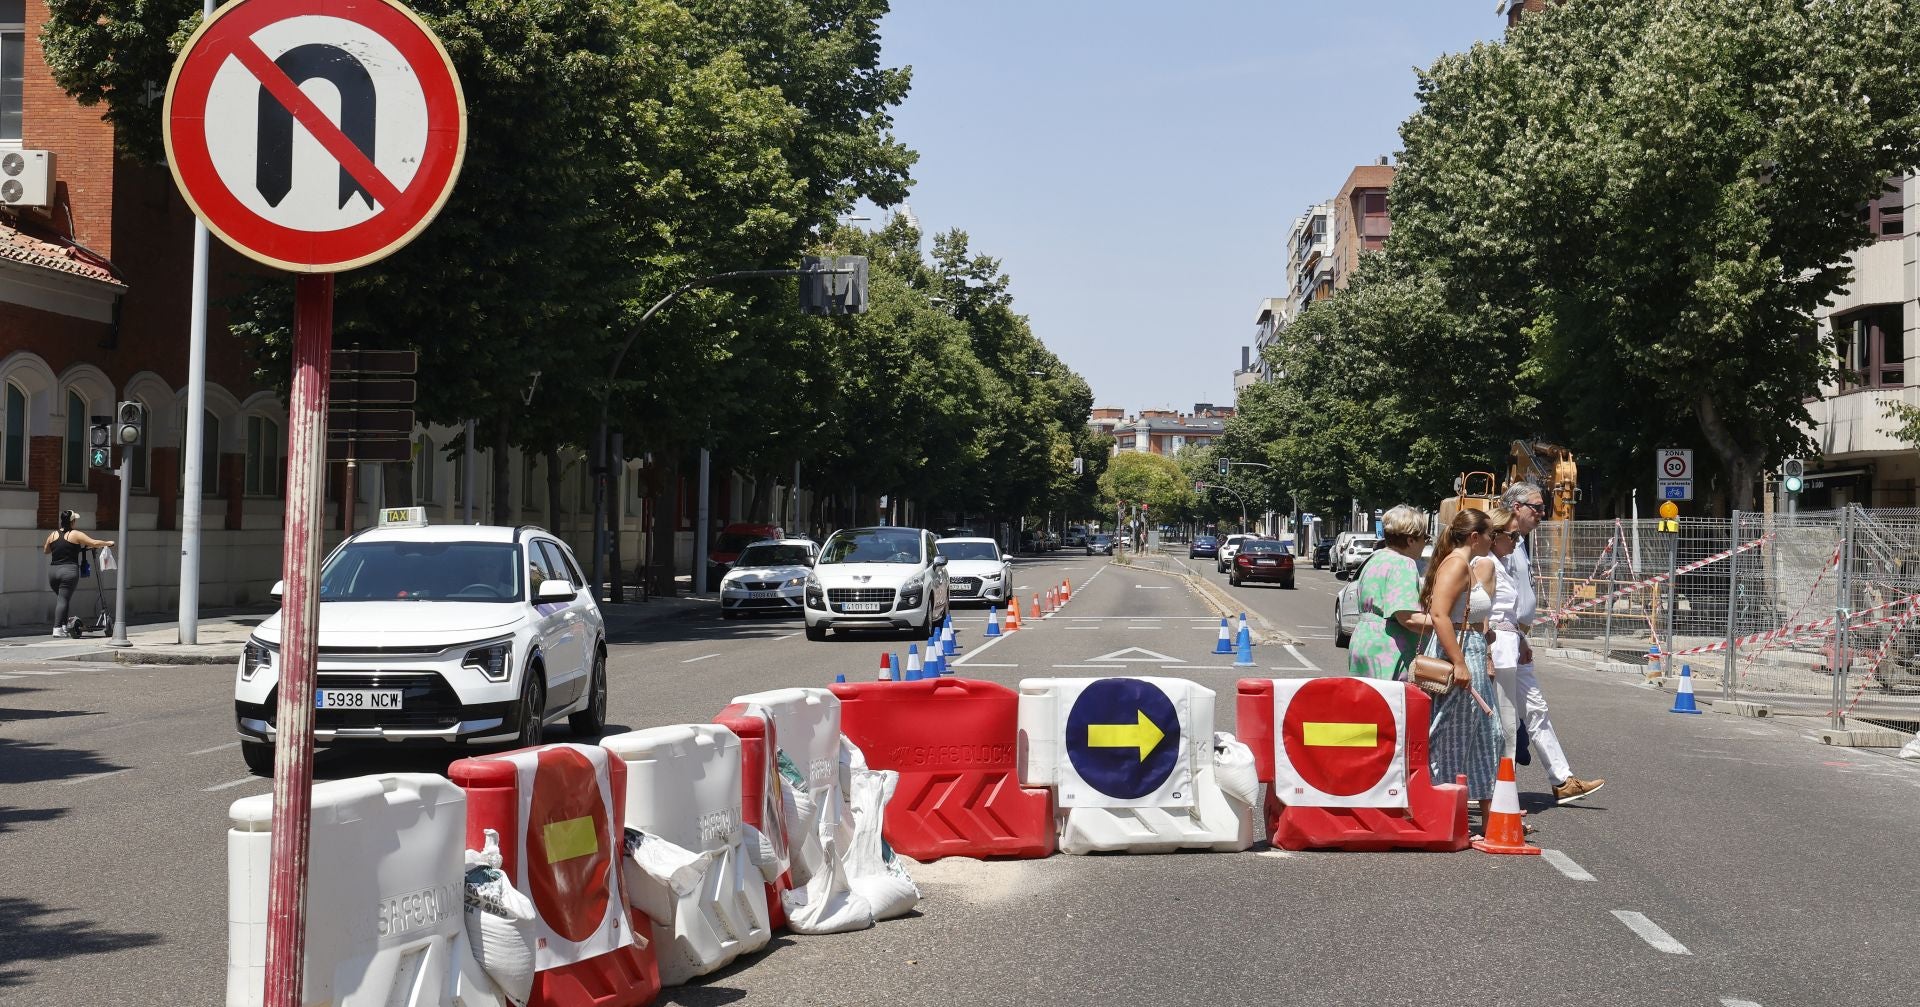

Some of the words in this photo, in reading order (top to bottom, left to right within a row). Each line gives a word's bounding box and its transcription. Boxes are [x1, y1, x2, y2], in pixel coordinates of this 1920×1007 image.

[1668, 463, 1681, 471] 30
[387, 510, 409, 521] TAXI
[327, 692, 363, 707] 5938
[371, 692, 398, 707] NCW
